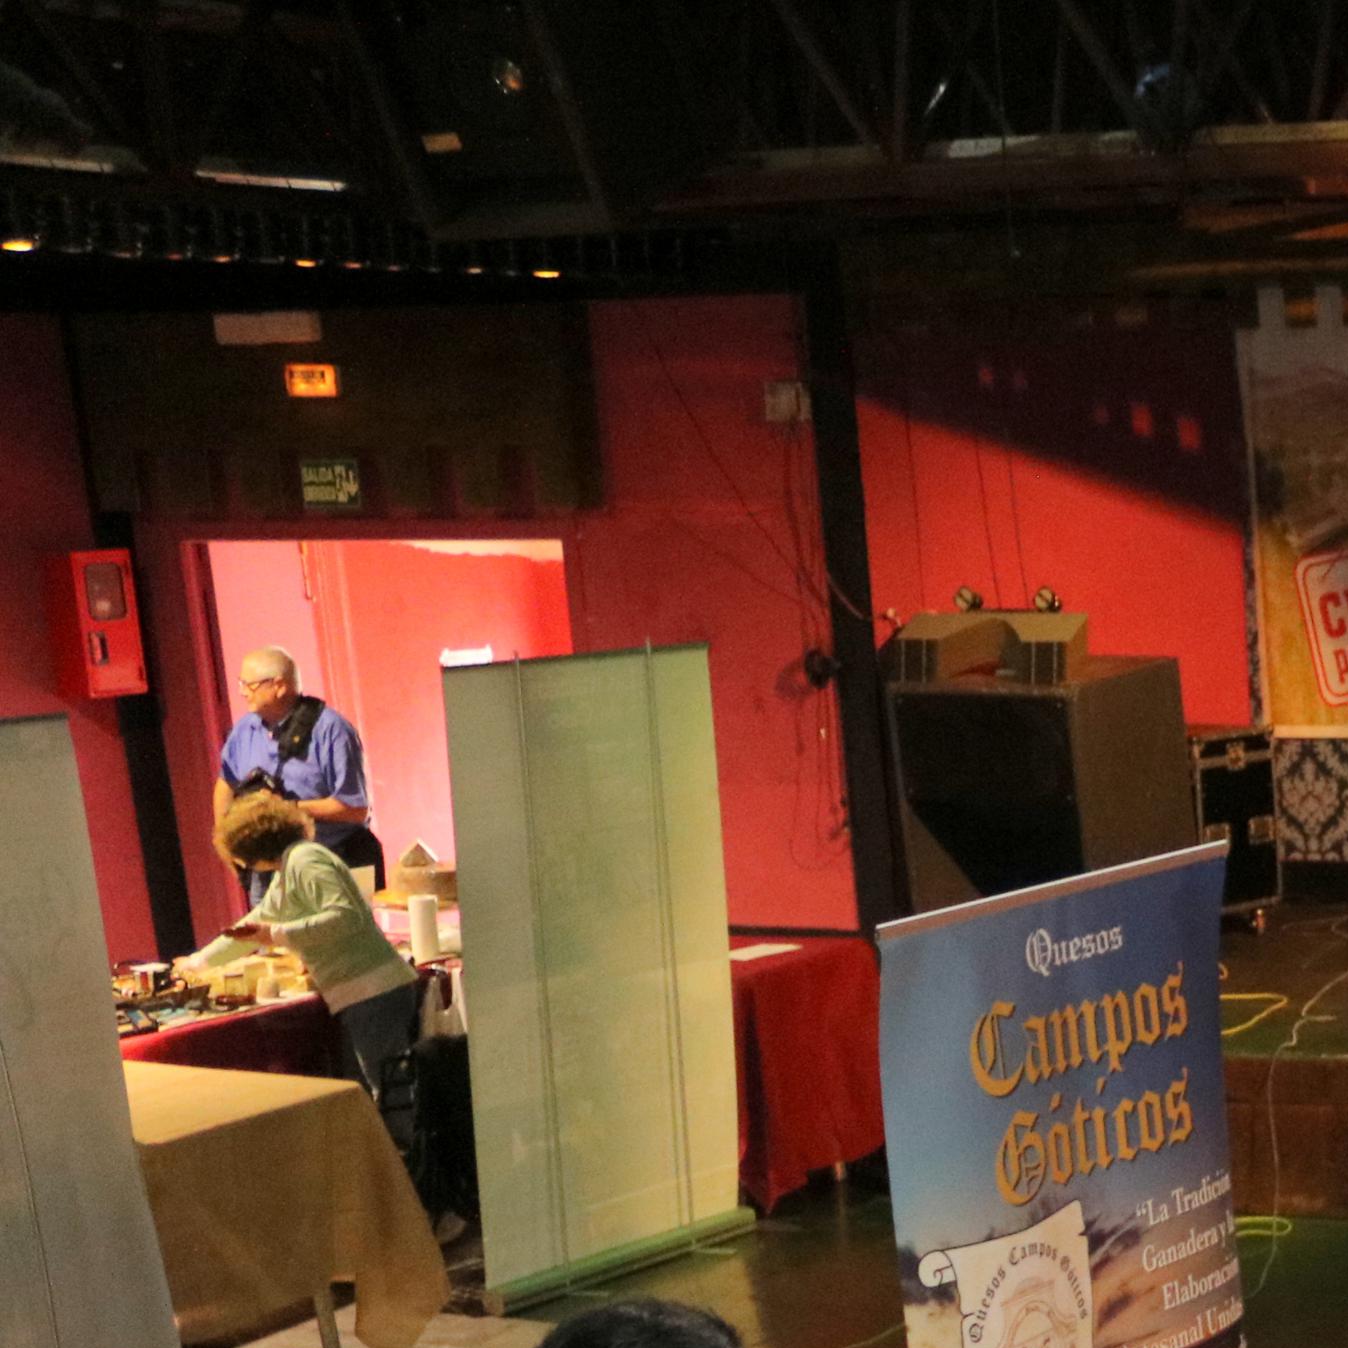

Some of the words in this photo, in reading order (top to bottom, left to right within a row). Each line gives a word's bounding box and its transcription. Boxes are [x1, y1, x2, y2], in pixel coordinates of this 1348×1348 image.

[1025, 924, 1124, 977] Quesos
[969, 961, 1189, 1098] Campos
[995, 1066, 1193, 1207] Góticos
[968, 1267, 1007, 1344] Quesos
[1008, 1241, 1059, 1266] Campos
[1142, 1228, 1219, 1272] Ganadera
[1218, 1221, 1227, 1247] y
